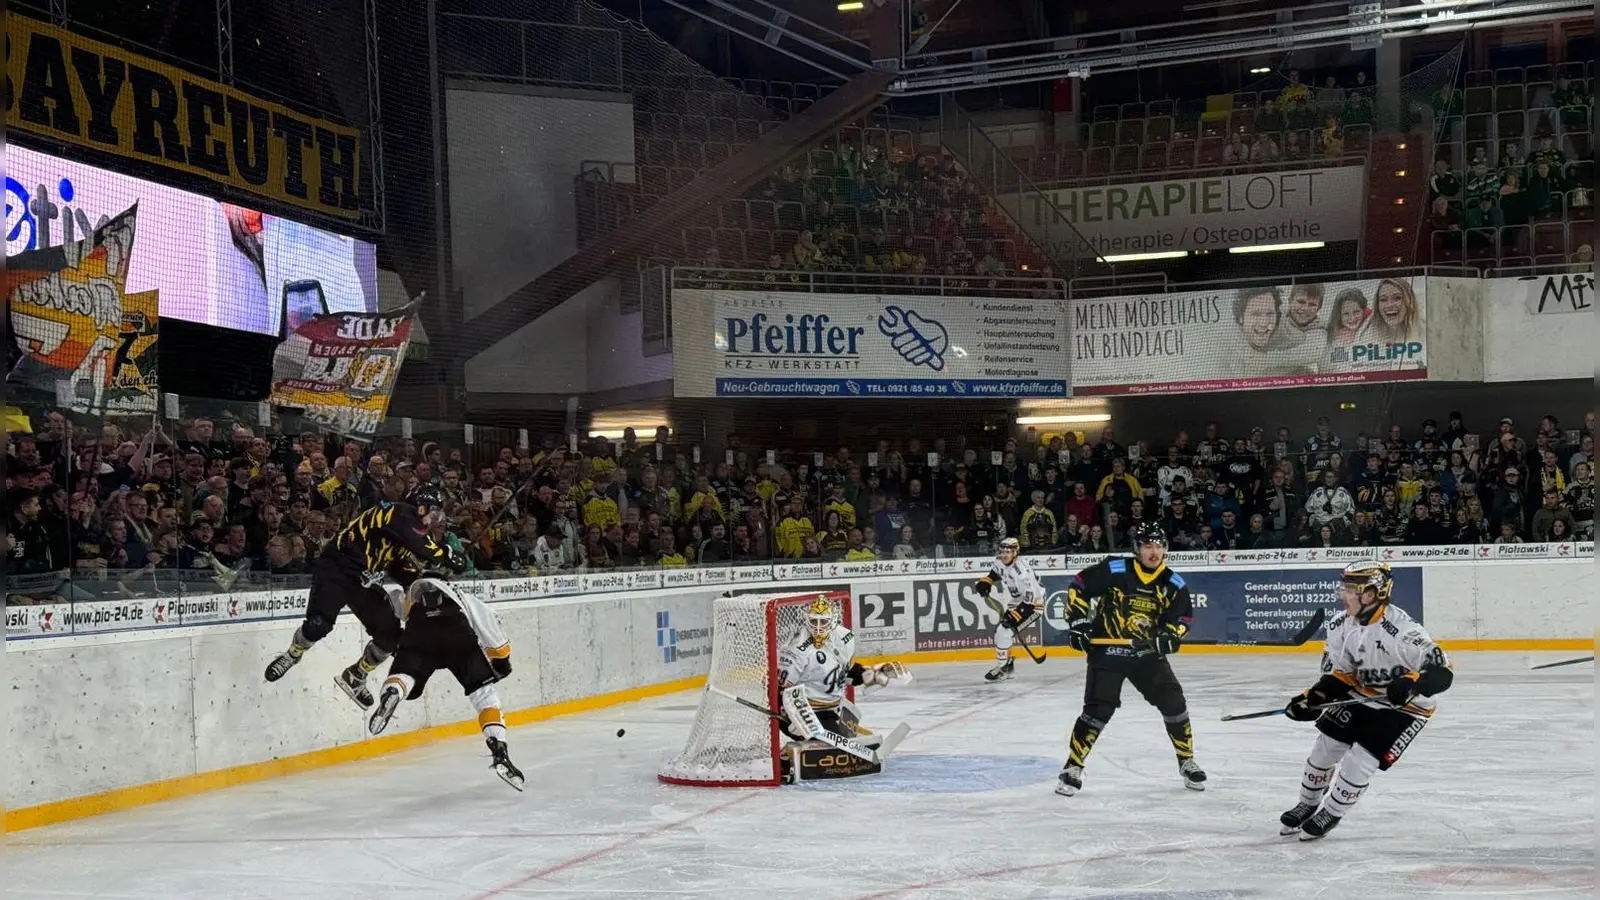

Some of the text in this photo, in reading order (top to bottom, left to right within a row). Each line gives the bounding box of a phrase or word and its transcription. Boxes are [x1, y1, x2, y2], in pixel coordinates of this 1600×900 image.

[6, 30, 359, 210] AYREUTH
[1026, 171, 1322, 225] THERAPIELOFT
[1193, 220, 1321, 247] Osteopathie
[1538, 274, 1594, 312] Mi
[983, 304, 1033, 312] Kundendienst
[1076, 296, 1220, 329] MEIN MÖBELHAUS
[983, 317, 1056, 326] Abgasuntersuchung
[724, 313, 865, 354] Pfeiffer
[984, 330, 1055, 339] Hauptuntersuchung
[984, 343, 1060, 352] Unfallinstandsetzung
[1076, 329, 1184, 359] IN BINDLACH
[984, 355, 1034, 363] Reifenservice
[985, 368, 1039, 377] Motordiagnose
[722, 381, 840, 394] Neu-Gebrauchtwagen
[866, 384, 886, 393] TEL:
[887, 384, 907, 393] 0921
[924, 384, 935, 393] 40
[936, 384, 947, 393] 36
[972, 382, 1063, 394] www.kfzpfeiffer.de
[1234, 551, 1298, 561] www.pio-24.de
[1325, 548, 1374, 557] Piotrowski
[1402, 547, 1469, 558] www.pio-24.de
[1498, 544, 1549, 554] Piotrowski
[843, 563, 894, 574] www.pio-24.de
[1245, 582, 1317, 592] Generalagentur
[1245, 595, 1279, 604] Telefon
[1281, 595, 1305, 604] 0921
[63, 605, 143, 626] www.pio-24.de
[168, 598, 219, 616] Piotrowski
[246, 595, 306, 613] www.pio-24.de
[861, 592, 905, 628] 2F
[1245, 621, 1304, 630] Telefon 0921
[859, 629, 907, 639] einrichtungen
